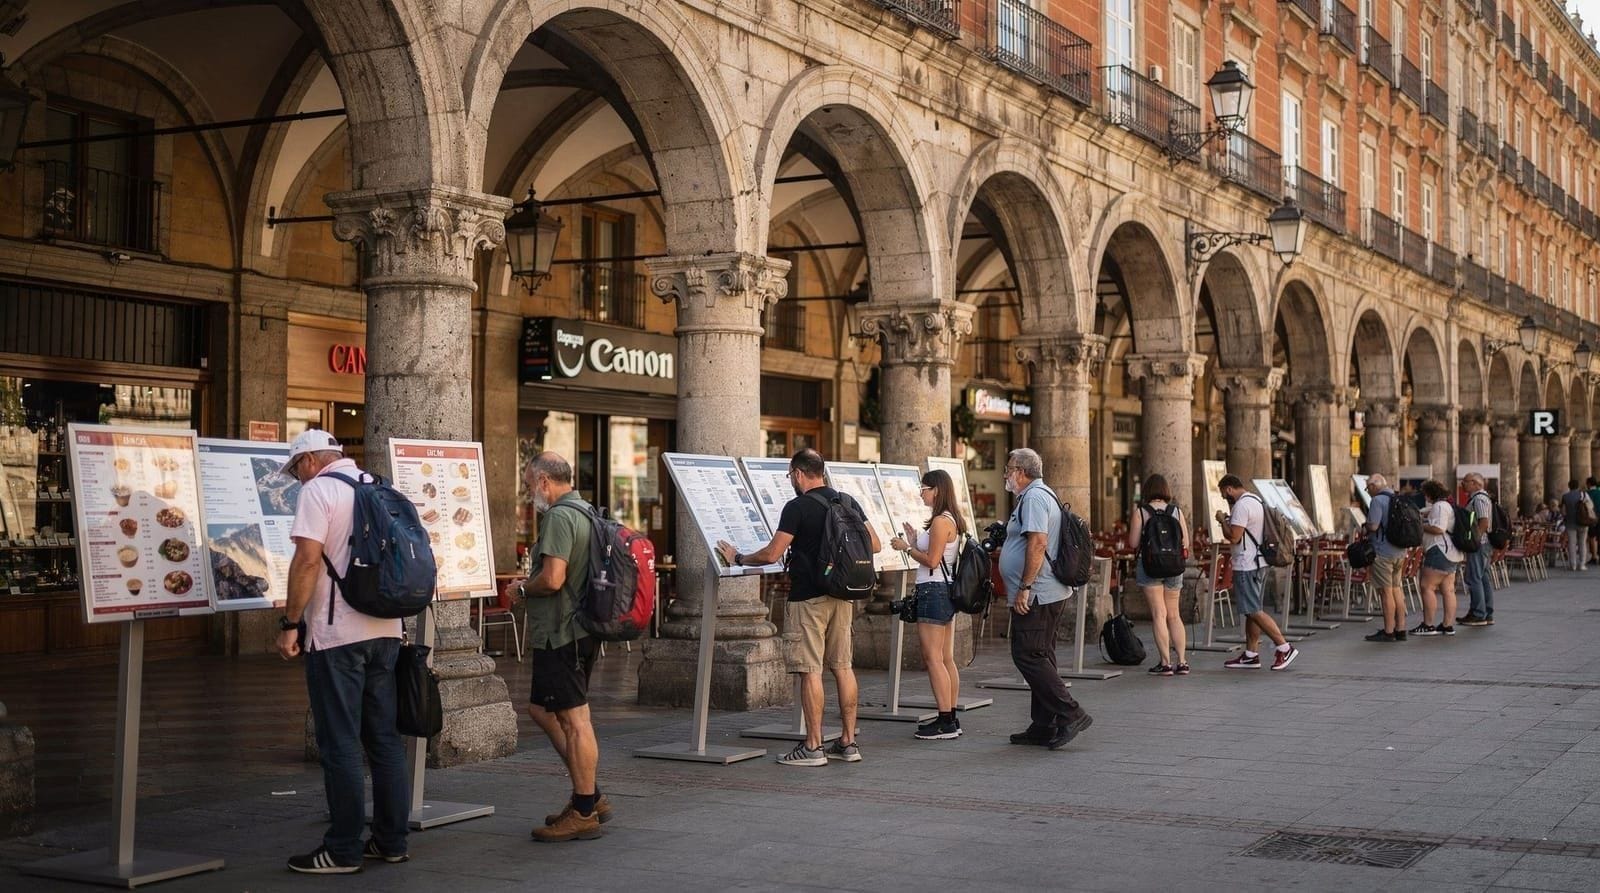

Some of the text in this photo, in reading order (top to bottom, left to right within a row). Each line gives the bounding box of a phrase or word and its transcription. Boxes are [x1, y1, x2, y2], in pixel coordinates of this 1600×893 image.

[330, 344, 367, 375] CAN
[589, 338, 674, 379] Canon
[1534, 411, 1555, 435] R
